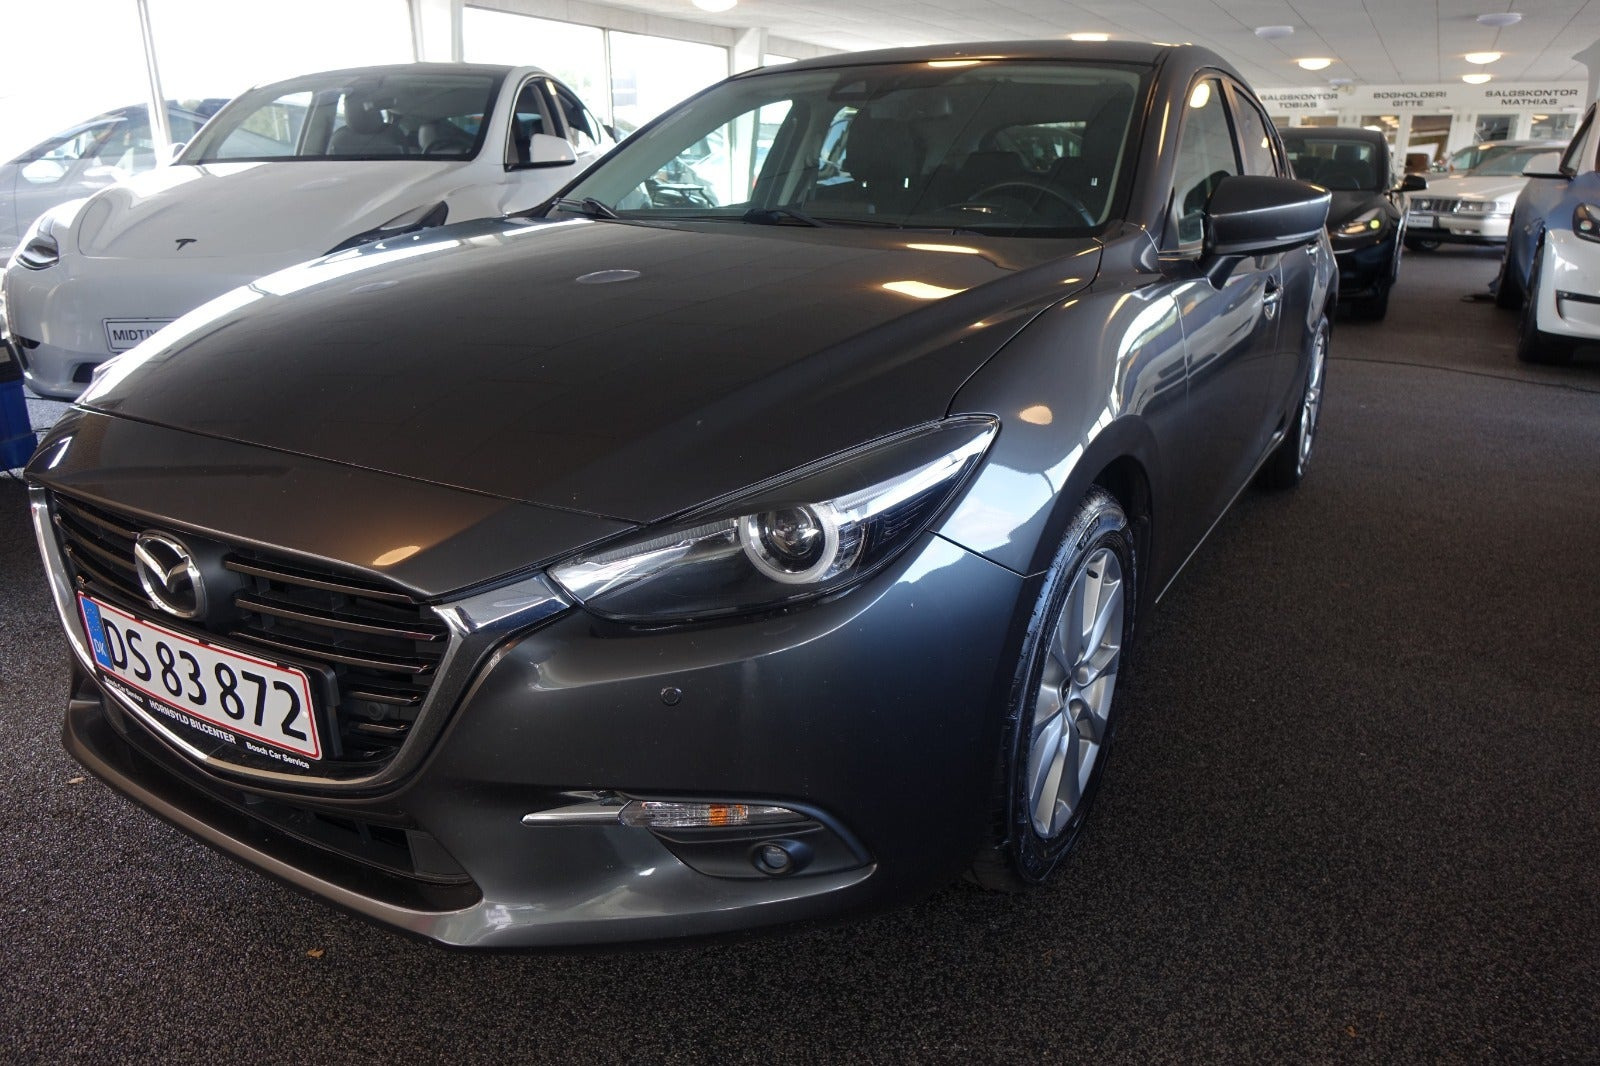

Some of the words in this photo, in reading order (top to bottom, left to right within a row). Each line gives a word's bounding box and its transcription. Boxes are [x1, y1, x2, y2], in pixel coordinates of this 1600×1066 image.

[1260, 92, 1338, 100] SALGSKONTOR
[1373, 91, 1447, 99] BOGHOLDERI
[1485, 89, 1578, 97] SALGSKONTOR
[93, 638, 107, 657] DK
[101, 617, 152, 682] DS
[156, 641, 207, 706] 83
[214, 662, 307, 742] 872
[149, 699, 189, 726] HORNSYLD
[190, 717, 237, 744] BILCENTER
[245, 741, 268, 756] Bosch
[268, 749, 282, 760] Car
[282, 753, 310, 769] Service
